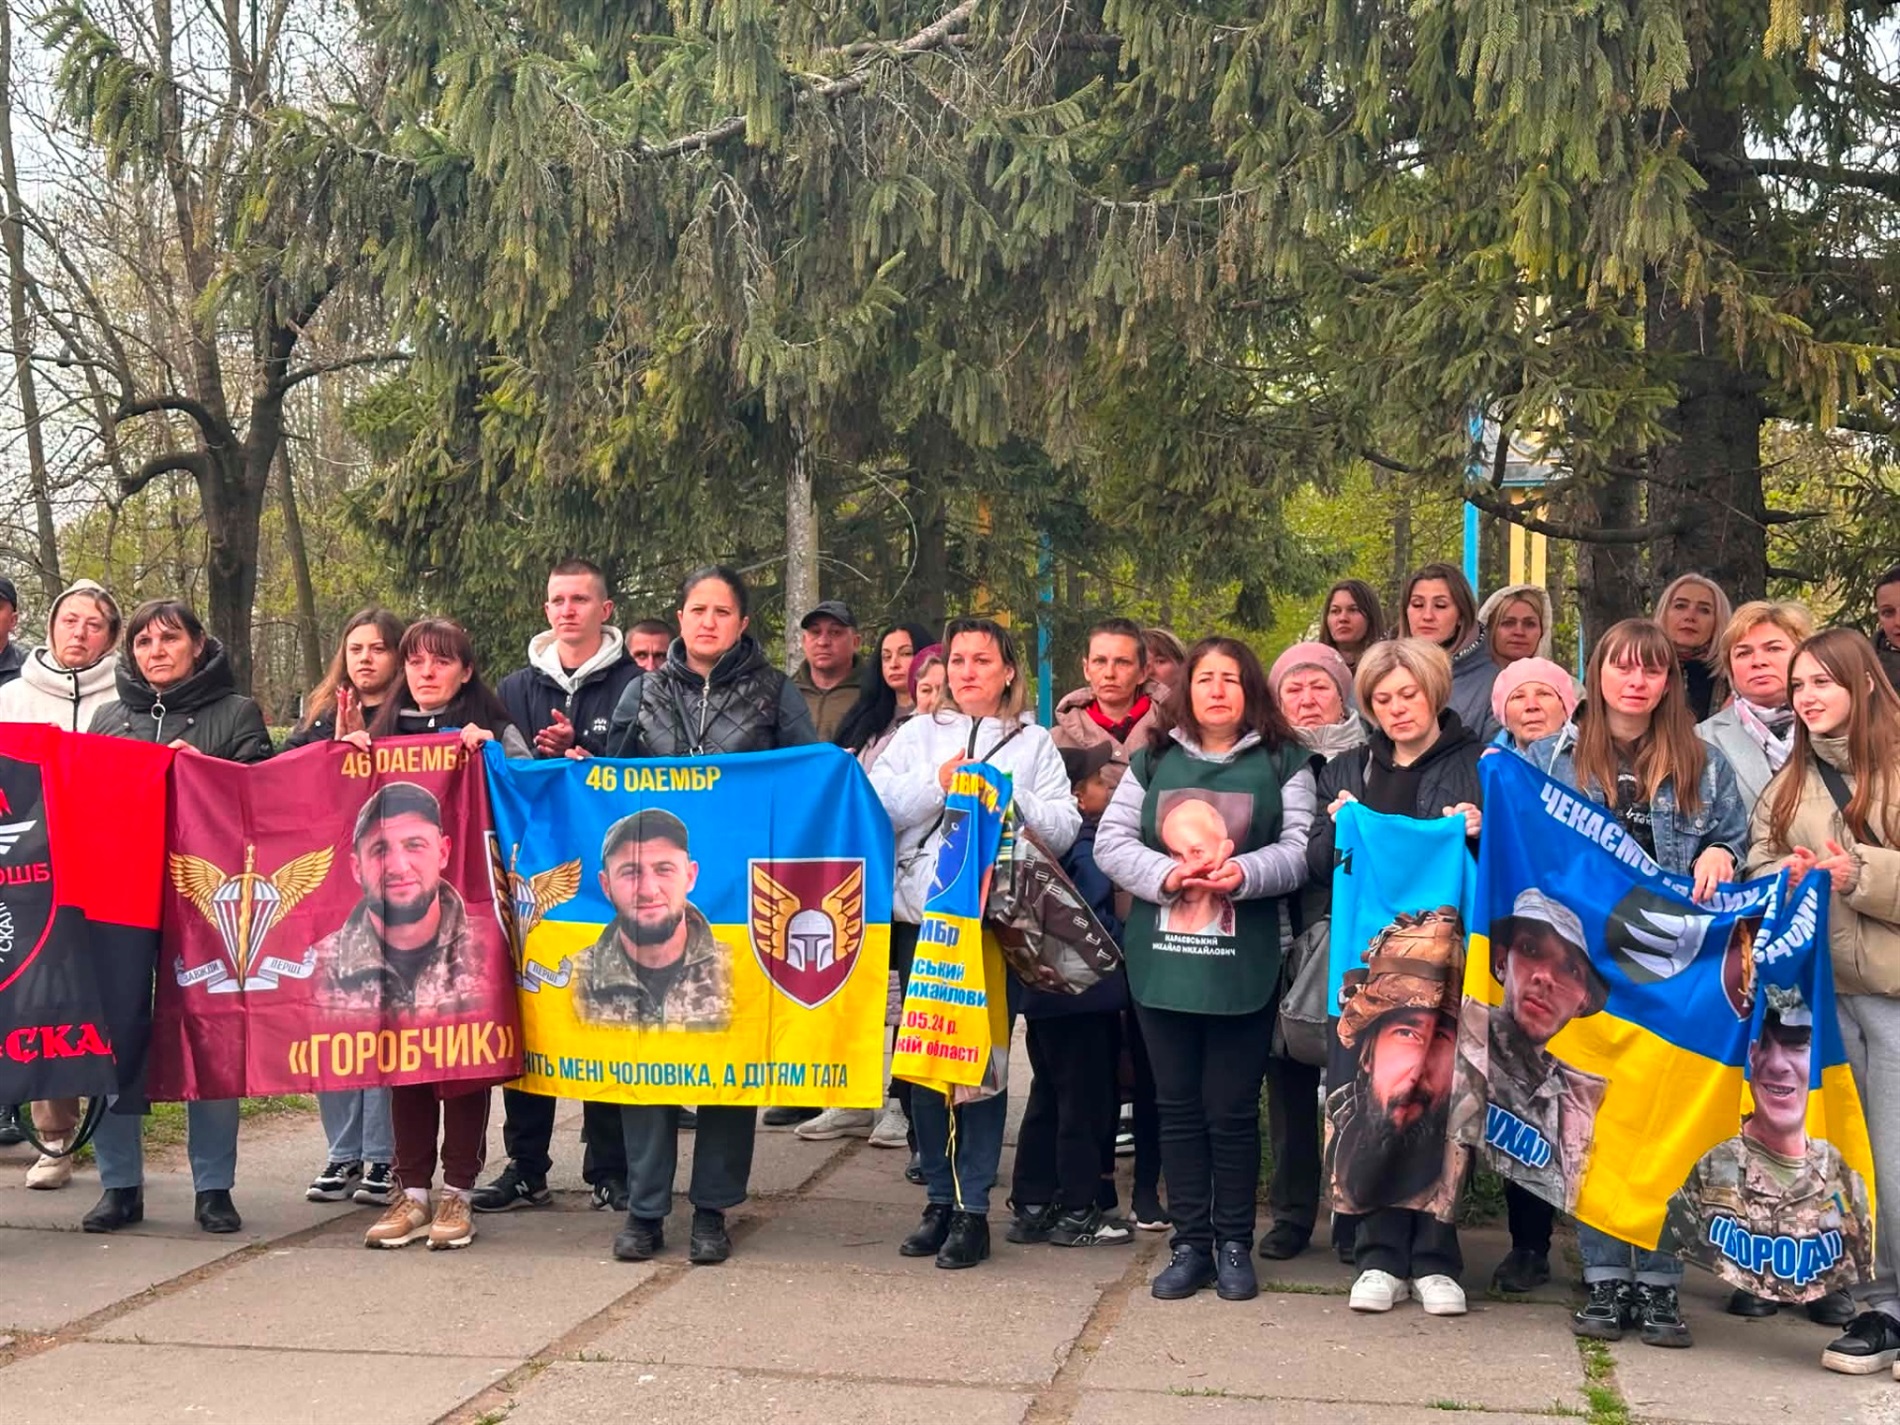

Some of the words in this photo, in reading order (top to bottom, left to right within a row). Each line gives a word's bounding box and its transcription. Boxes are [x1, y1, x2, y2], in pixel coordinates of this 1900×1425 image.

[341, 752, 372, 779] 46
[585, 765, 618, 792] 46
[624, 766, 722, 792] ОАЕМБР
[0, 862, 51, 886] ШБ
[912, 958, 965, 981] ський
[288, 1021, 515, 1078] «ГОРОБЧИК»
[926, 1039, 979, 1063] області
[558, 1056, 604, 1083] МЕНІ
[609, 1060, 717, 1089] ЧОЛОВІКА,
[723, 1063, 737, 1087] А
[741, 1062, 806, 1089] ДІТЯМ
[811, 1063, 848, 1088] ТАТА
